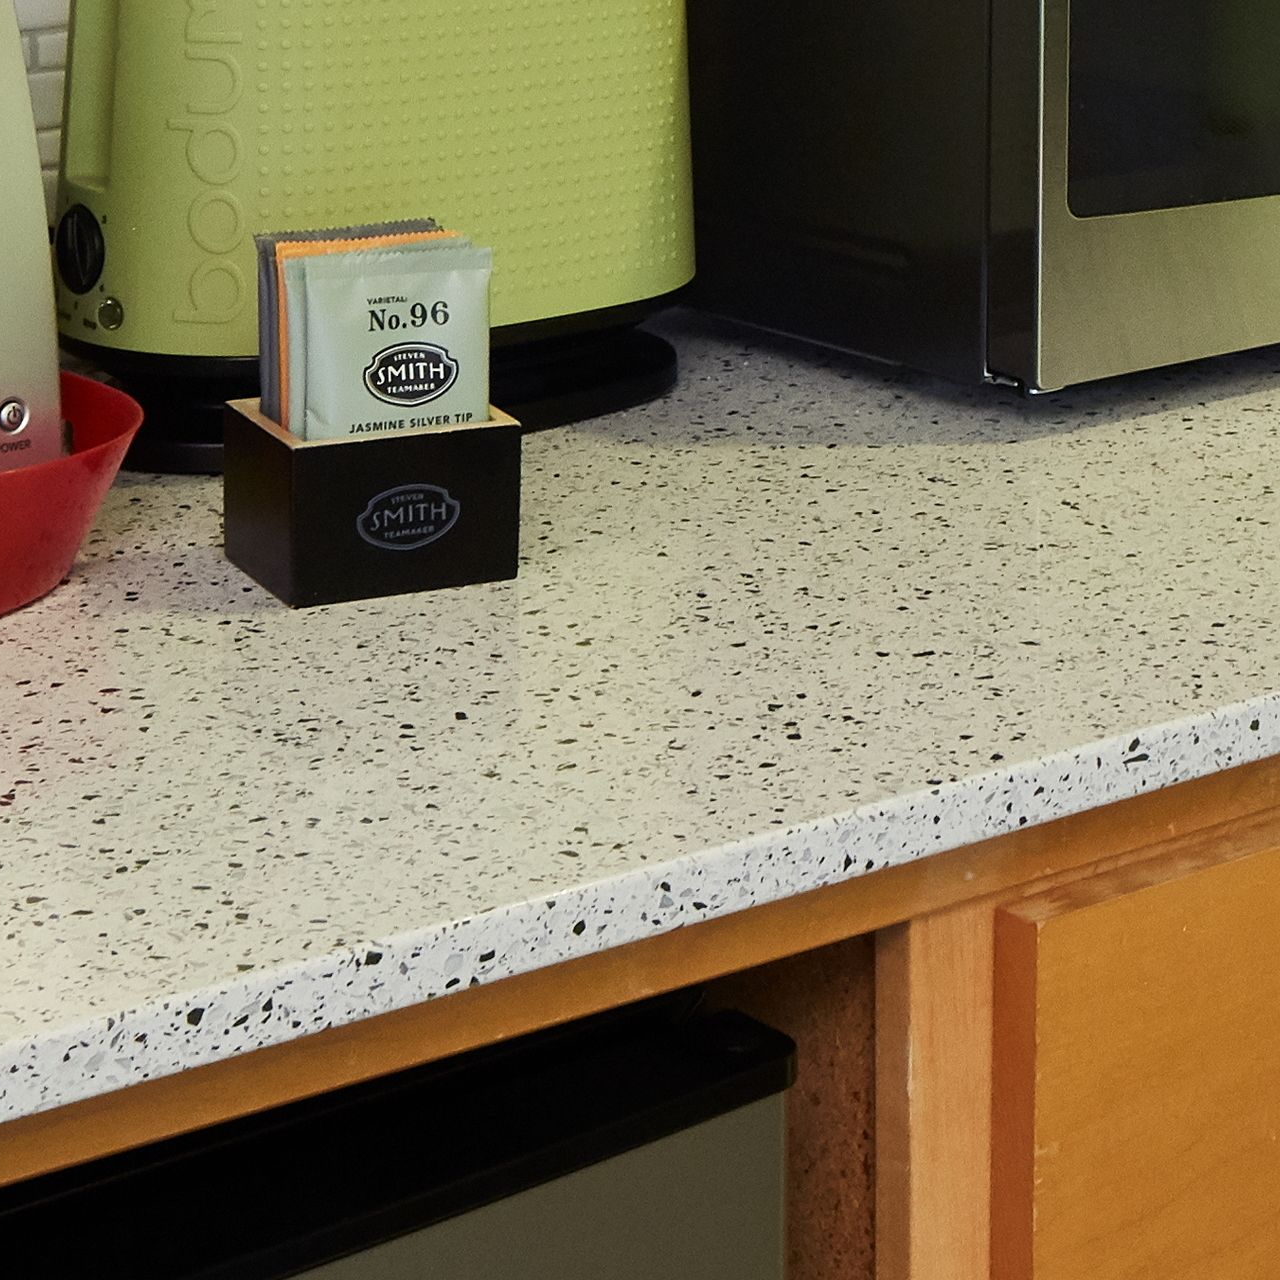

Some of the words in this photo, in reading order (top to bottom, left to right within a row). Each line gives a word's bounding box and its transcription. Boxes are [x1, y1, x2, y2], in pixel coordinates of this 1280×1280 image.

[393, 352, 426, 361] STEVEN
[376, 362, 445, 385] SMITH
[387, 382, 435, 394] TEAMAKER
[349, 419, 406, 434] JASMINE
[410, 414, 450, 428] SILVER
[454, 412, 473, 424] TIP
[391, 493, 425, 505] STEVEN
[370, 502, 447, 532] SMITH
[384, 525, 436, 540] TEAMAKER
